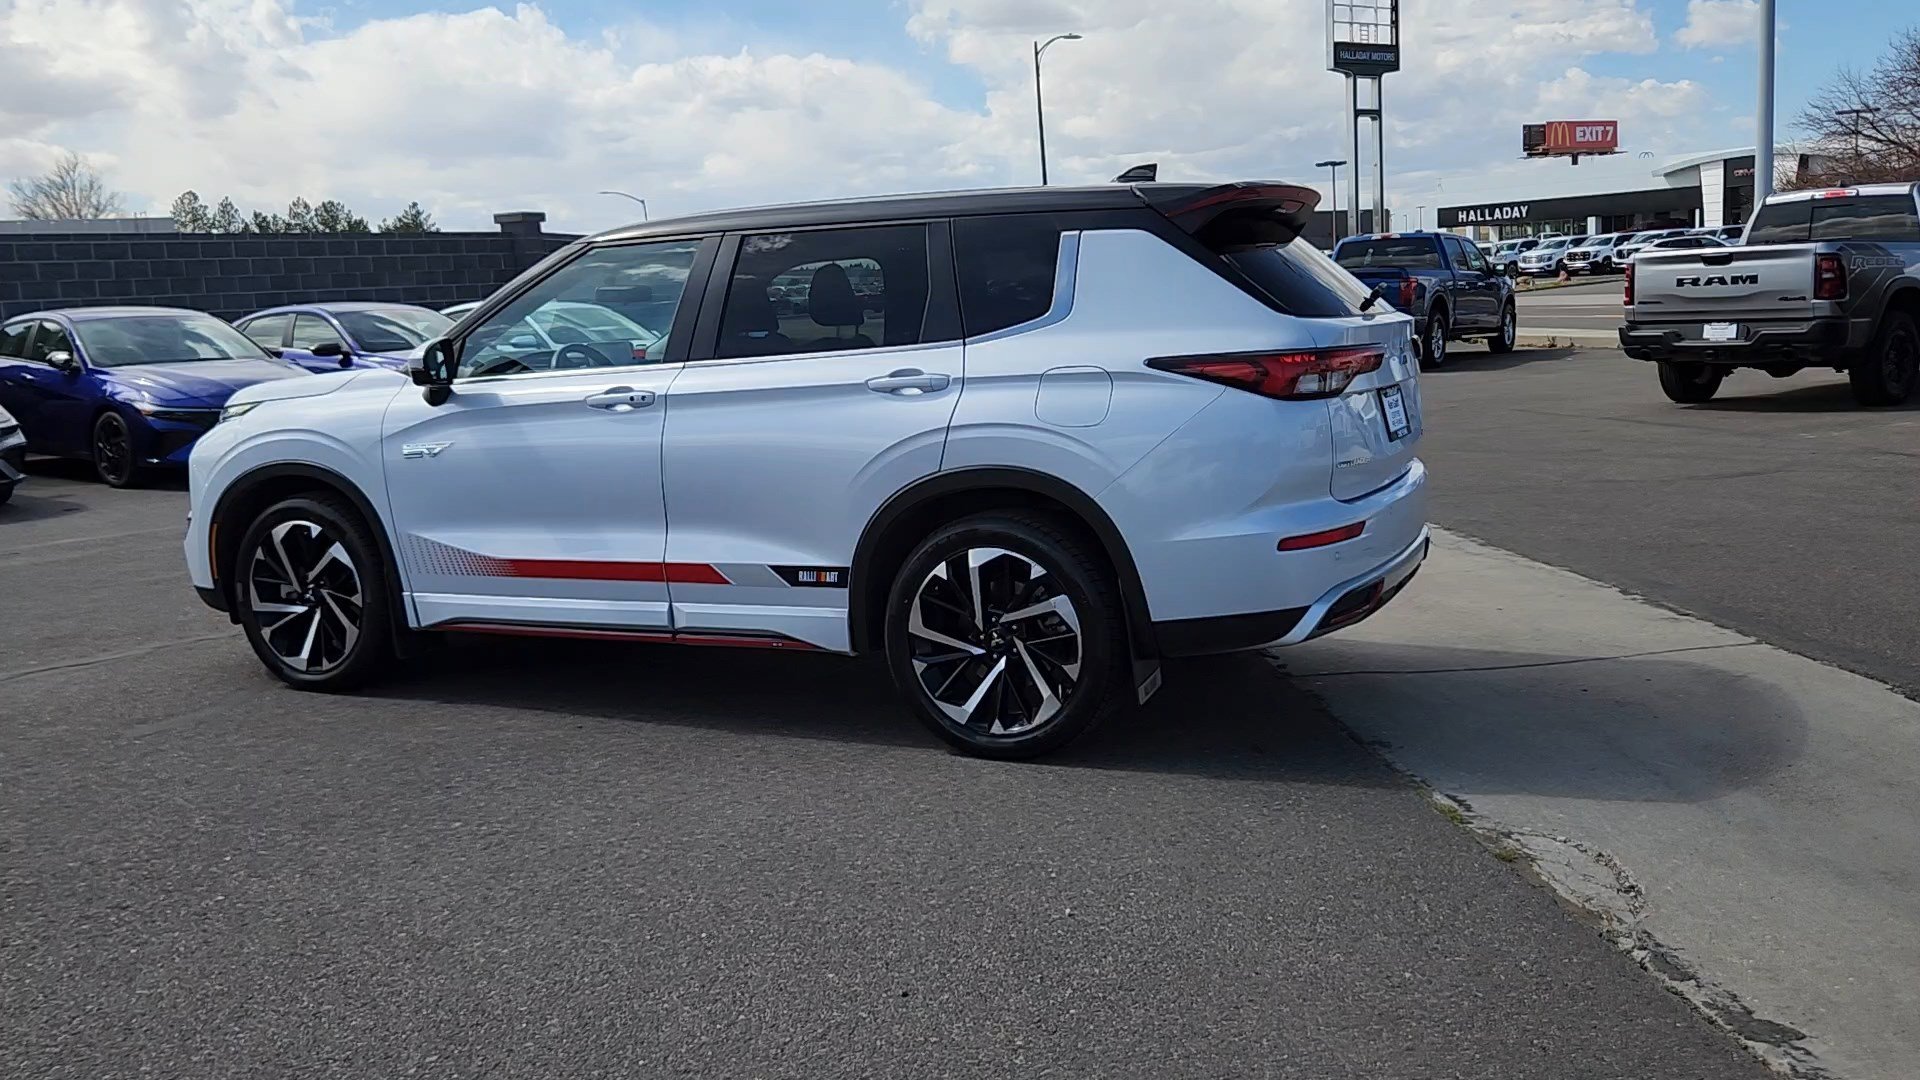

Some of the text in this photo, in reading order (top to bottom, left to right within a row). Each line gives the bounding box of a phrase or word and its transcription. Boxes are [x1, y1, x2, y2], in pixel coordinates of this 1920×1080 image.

[1340, 51, 1395, 61] HALLADAY MOTORS
[1575, 126, 1614, 142] EXIT 7
[1458, 205, 1528, 222] HALLADAY
[1676, 273, 1758, 287] RAM
